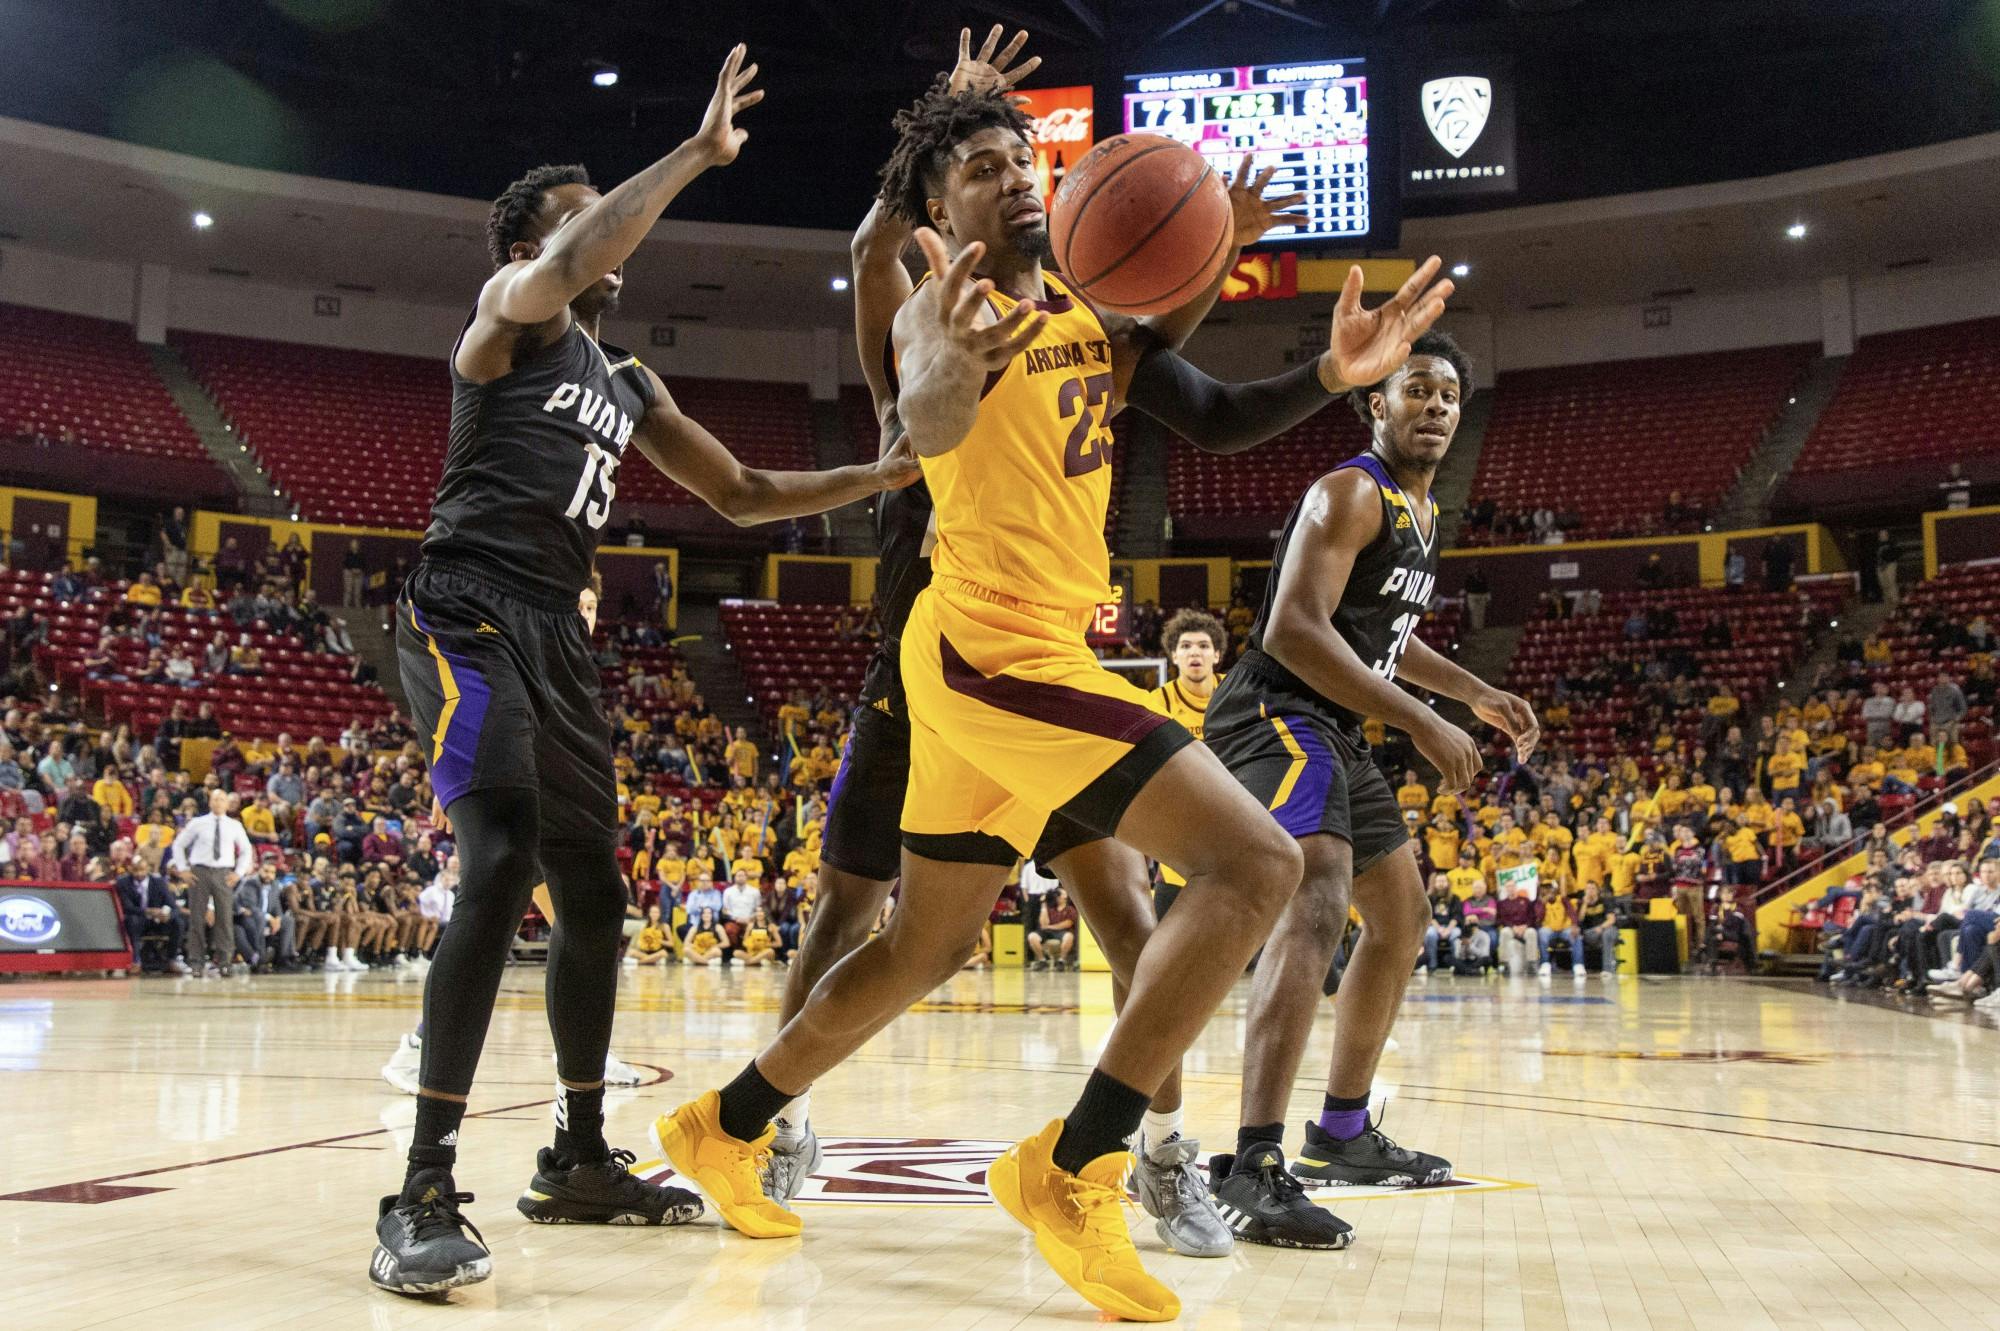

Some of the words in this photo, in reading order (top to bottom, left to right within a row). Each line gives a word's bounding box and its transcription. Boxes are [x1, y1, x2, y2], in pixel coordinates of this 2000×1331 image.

[1141, 98, 1187, 128] 72
[1445, 119, 1471, 140] 12
[1411, 165, 1505, 181] NETWORKS
[1058, 372, 1115, 478] 23
[565, 443, 621, 530] 15
